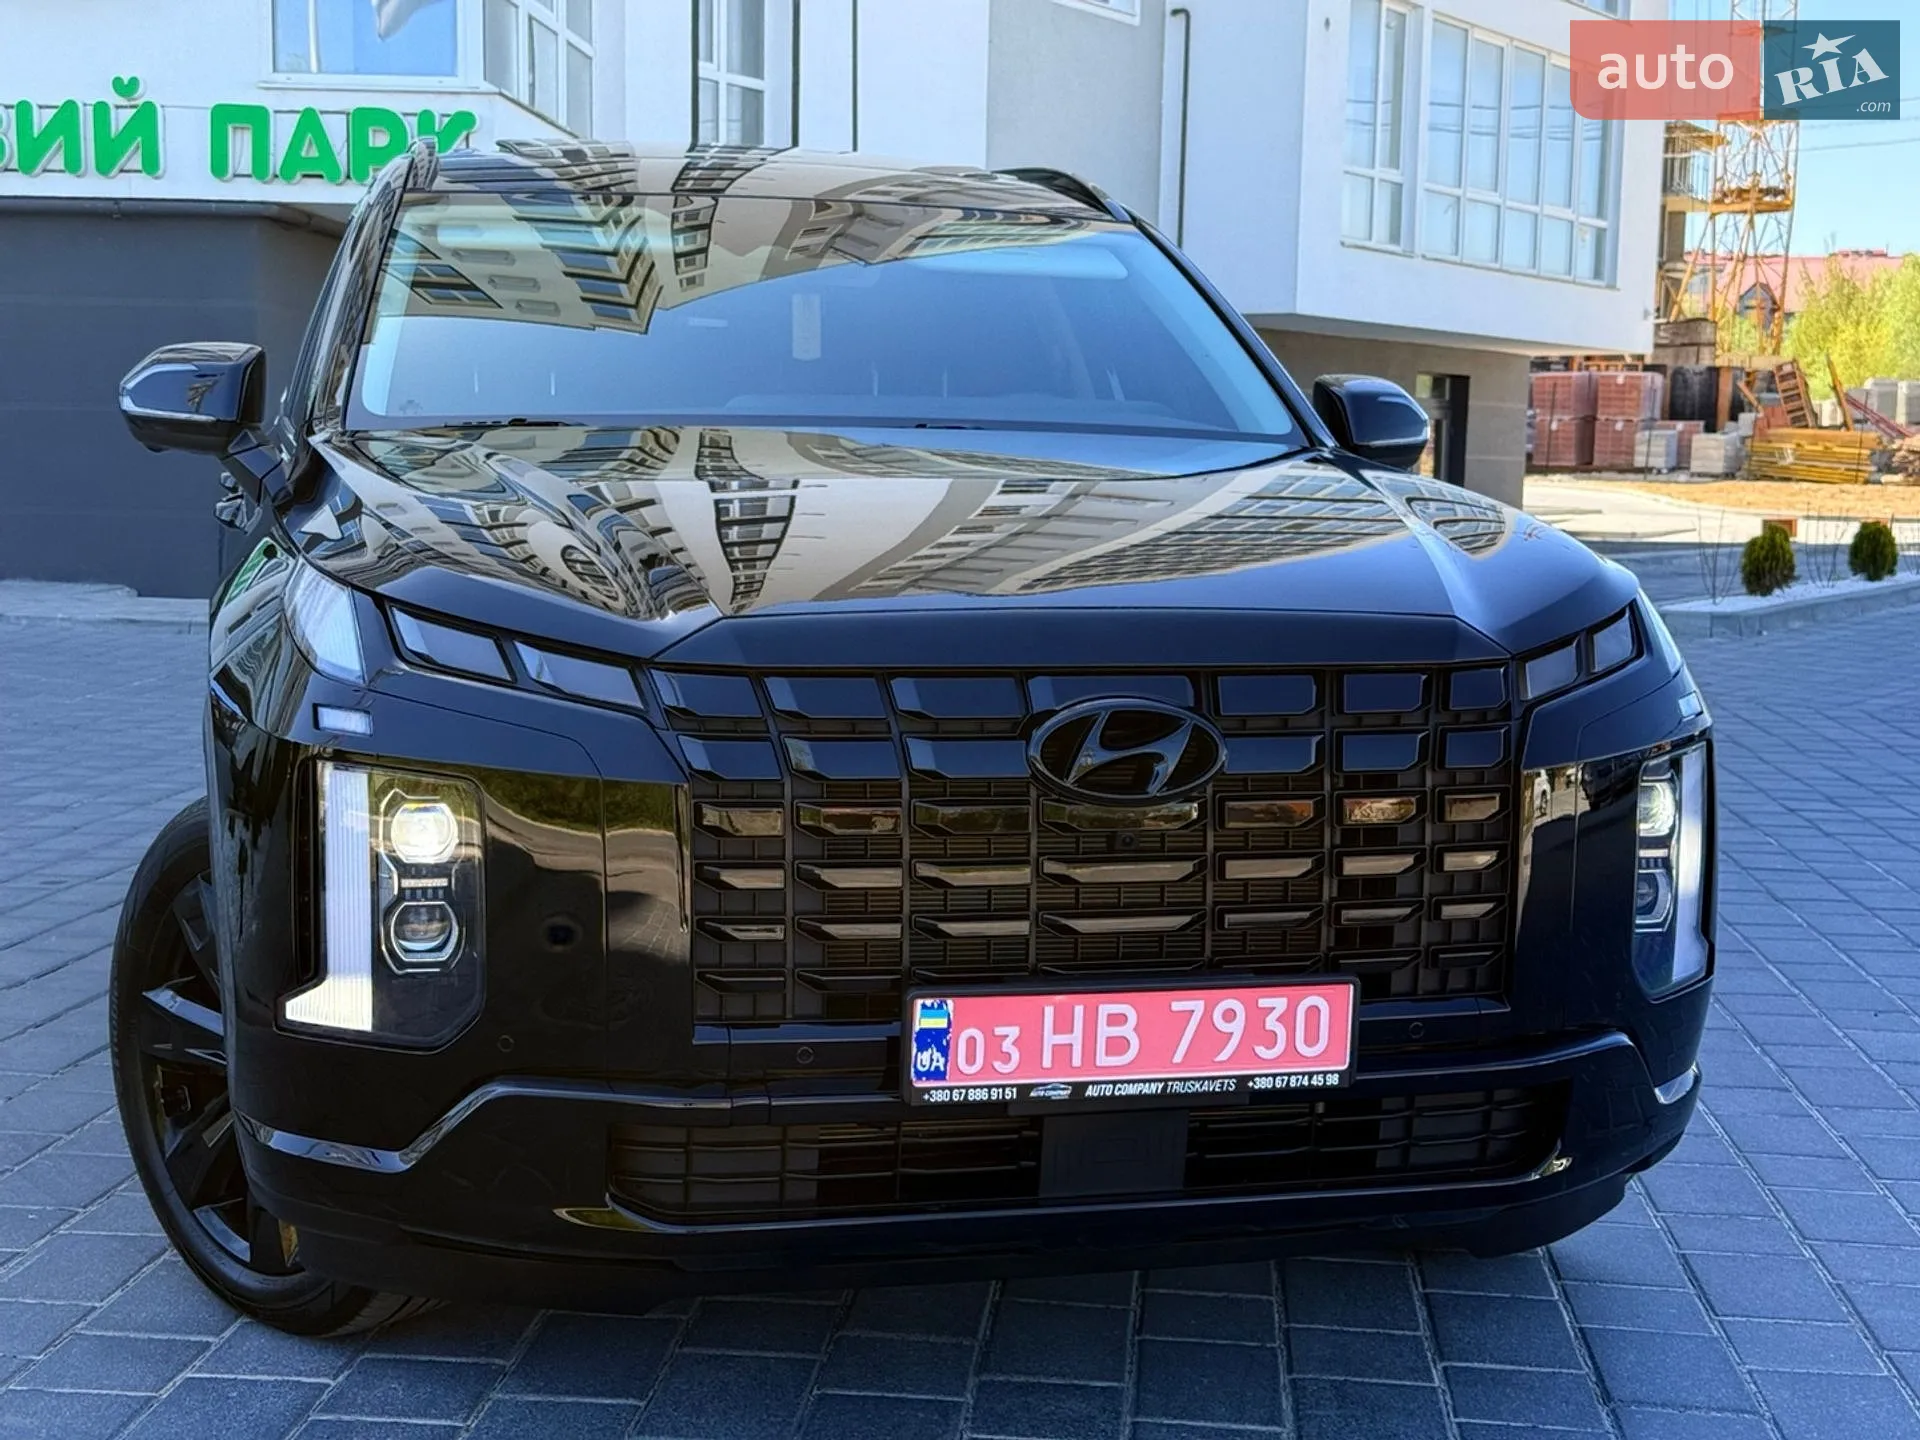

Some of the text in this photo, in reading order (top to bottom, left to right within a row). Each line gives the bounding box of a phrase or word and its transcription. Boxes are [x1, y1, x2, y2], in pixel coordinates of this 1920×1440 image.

[0, 76, 163, 177] ИЙ
[916, 1047, 946, 1072] UA
[957, 995, 1330, 1075] 03 HB 7930
[923, 1089, 950, 1102] +380
[952, 1088, 966, 1101] 67
[1085, 1083, 1113, 1097] AUTO
[1114, 1082, 1165, 1096] COMPANY
[1166, 1078, 1237, 1094] TRUSKAVETS
[1247, 1076, 1274, 1089] +380
[1275, 1075, 1288, 1088] 67
[1289, 1074, 1308, 1087] 874
